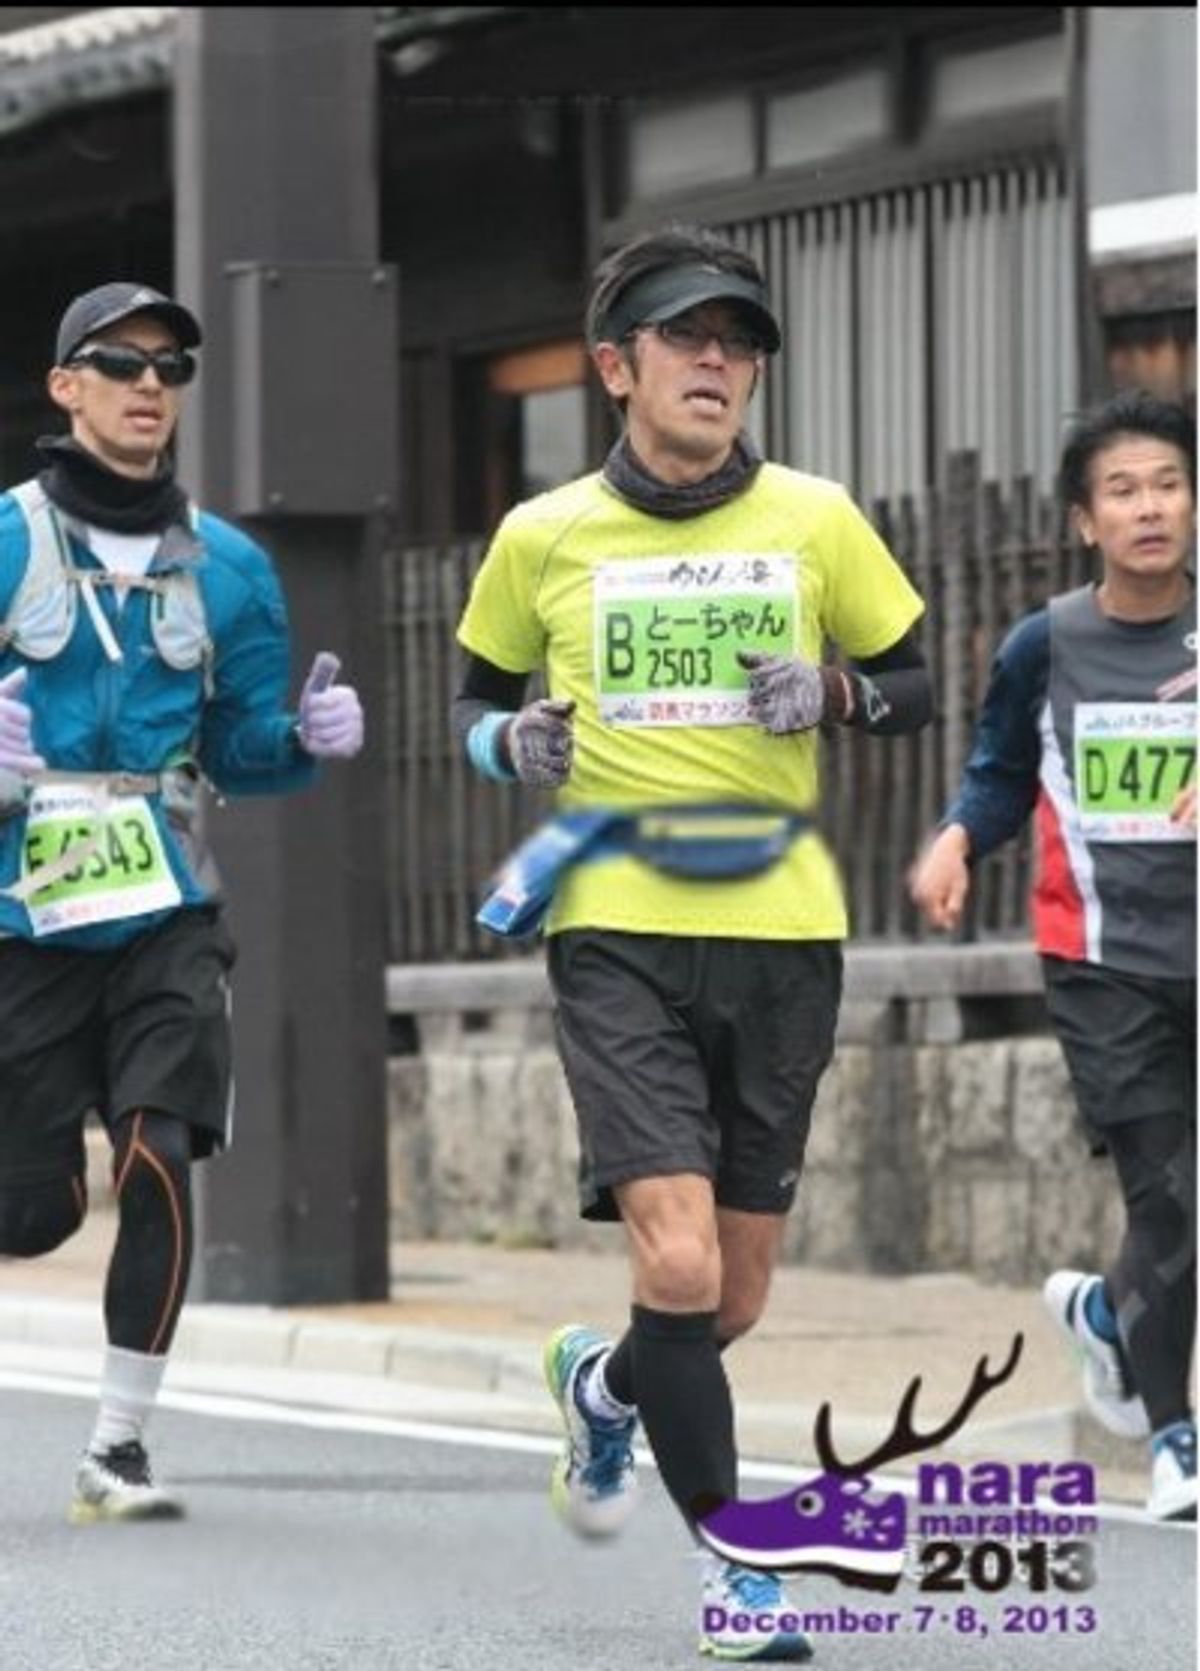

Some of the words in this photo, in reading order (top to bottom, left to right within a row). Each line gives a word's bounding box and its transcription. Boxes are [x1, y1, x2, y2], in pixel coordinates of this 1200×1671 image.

[647, 603, 785, 640] とーちゃん
[606, 613, 634, 678] B
[647, 648, 712, 687] 2503
[1085, 748, 1108, 802] D
